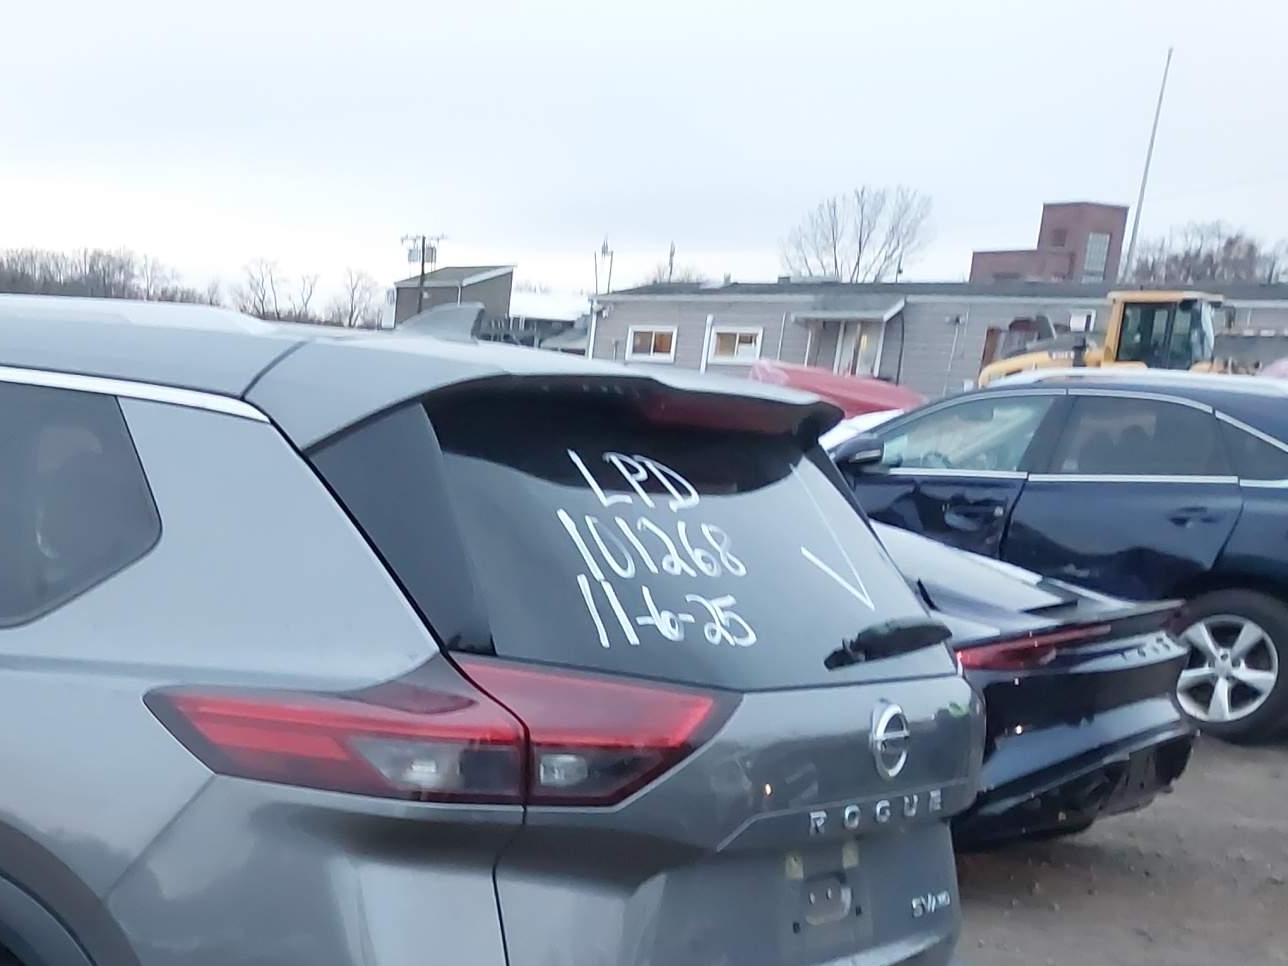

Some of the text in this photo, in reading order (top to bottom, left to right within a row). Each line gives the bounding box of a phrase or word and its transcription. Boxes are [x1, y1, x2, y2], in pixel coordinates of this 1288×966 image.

[567, 449, 700, 512] LPD
[557, 508, 746, 581] 101268
[577, 574, 757, 648] 11-6-25
[809, 789, 942, 836] ROGUE
